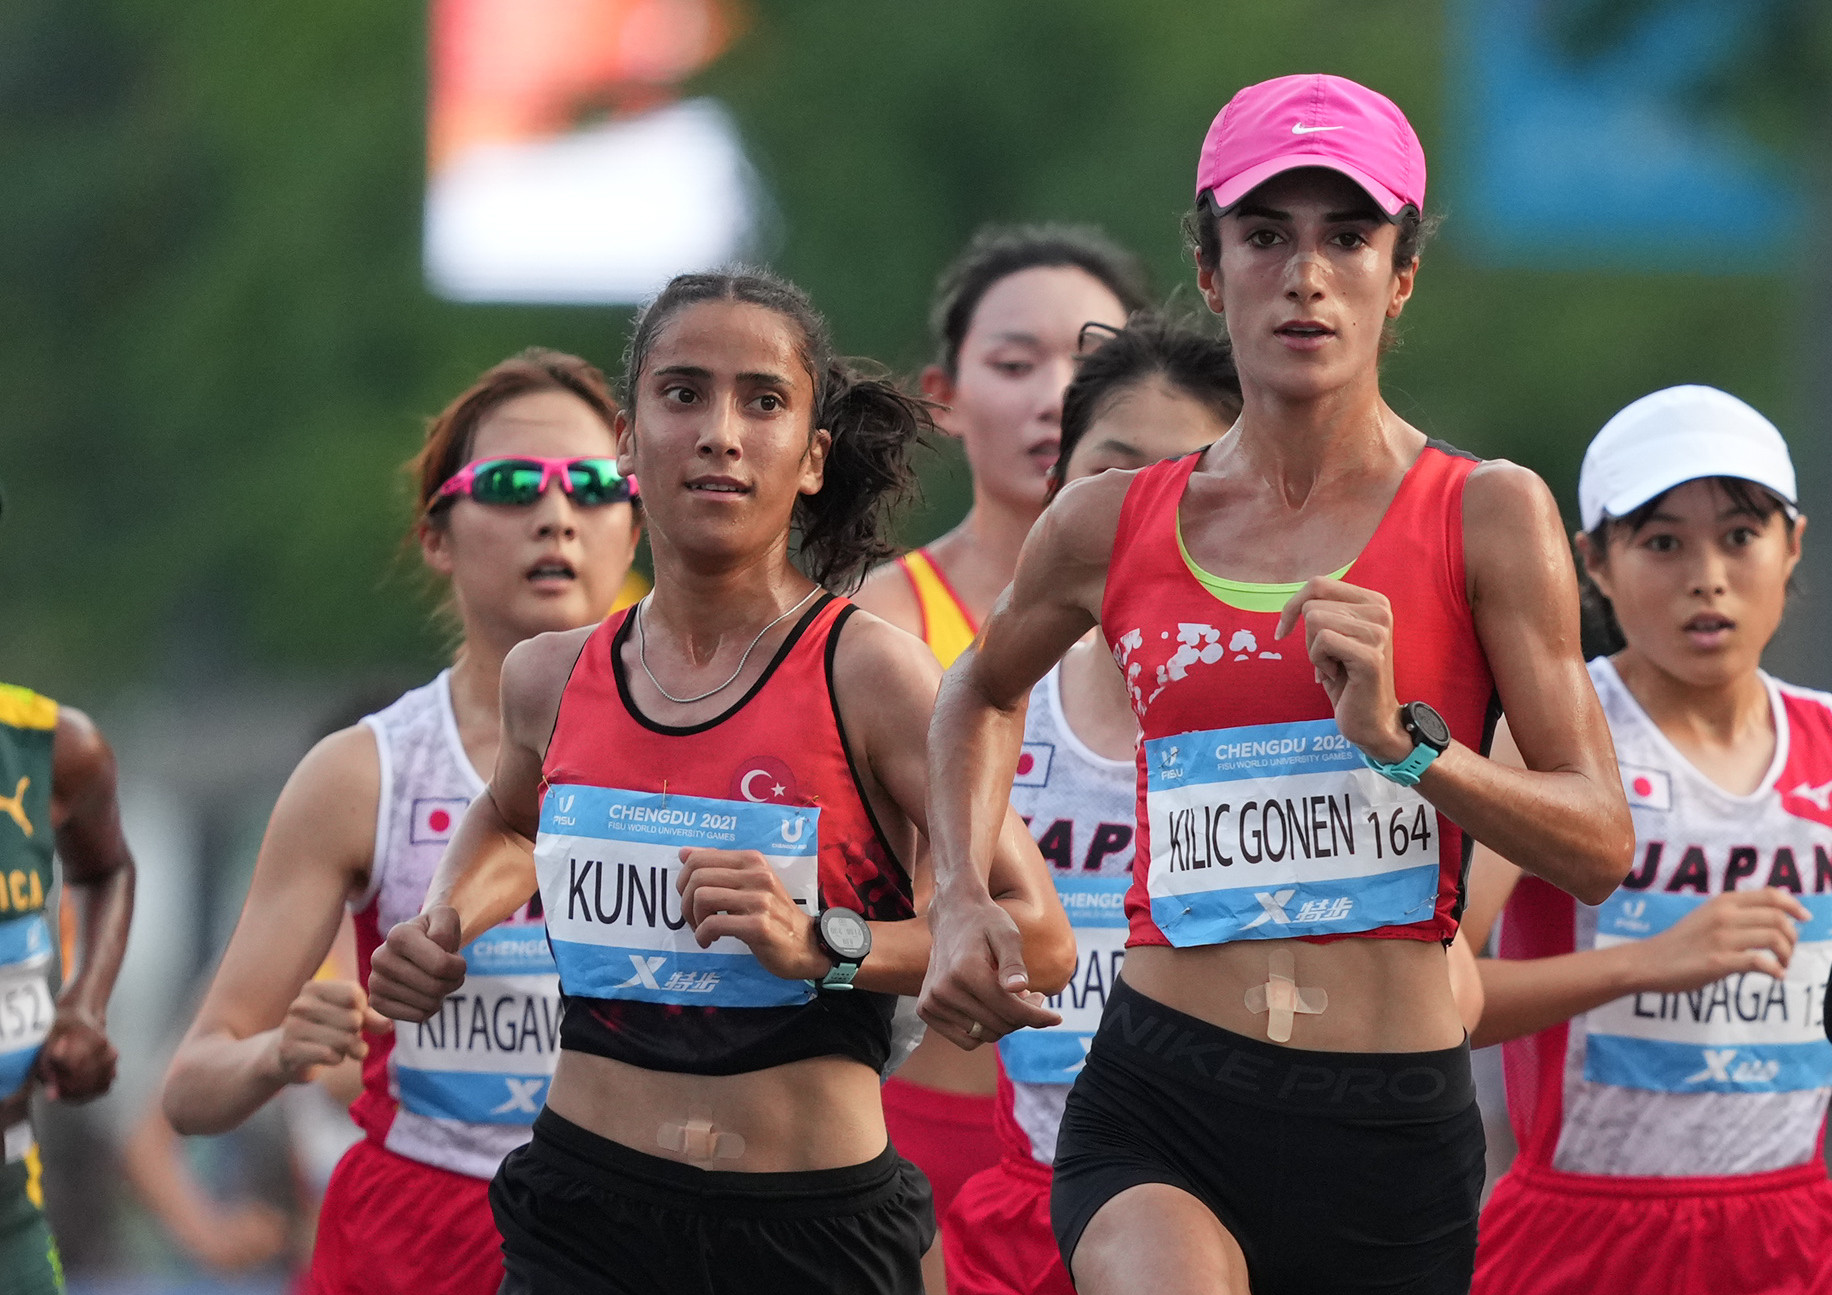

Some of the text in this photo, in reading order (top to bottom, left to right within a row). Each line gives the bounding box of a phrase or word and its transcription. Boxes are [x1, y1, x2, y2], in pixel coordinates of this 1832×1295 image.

[1215, 737, 1307, 760] CHENGDU
[1236, 759, 1268, 769] WORLD
[1269, 754, 1319, 767] UNIVERSITY
[1321, 751, 1353, 761] GAMES
[1161, 767, 1184, 780] FISU
[609, 804, 737, 831] CHENGDU 2021
[608, 821, 736, 842] FISU WORLD UNIVERSITY GAMES
[1169, 793, 1431, 873] KILIC GONEN 164
[1022, 816, 1133, 872] AP
[1057, 892, 1124, 909] HENGD
[1104, 1001, 1275, 1093] NIKE
[1277, 1063, 1447, 1105] PRO
